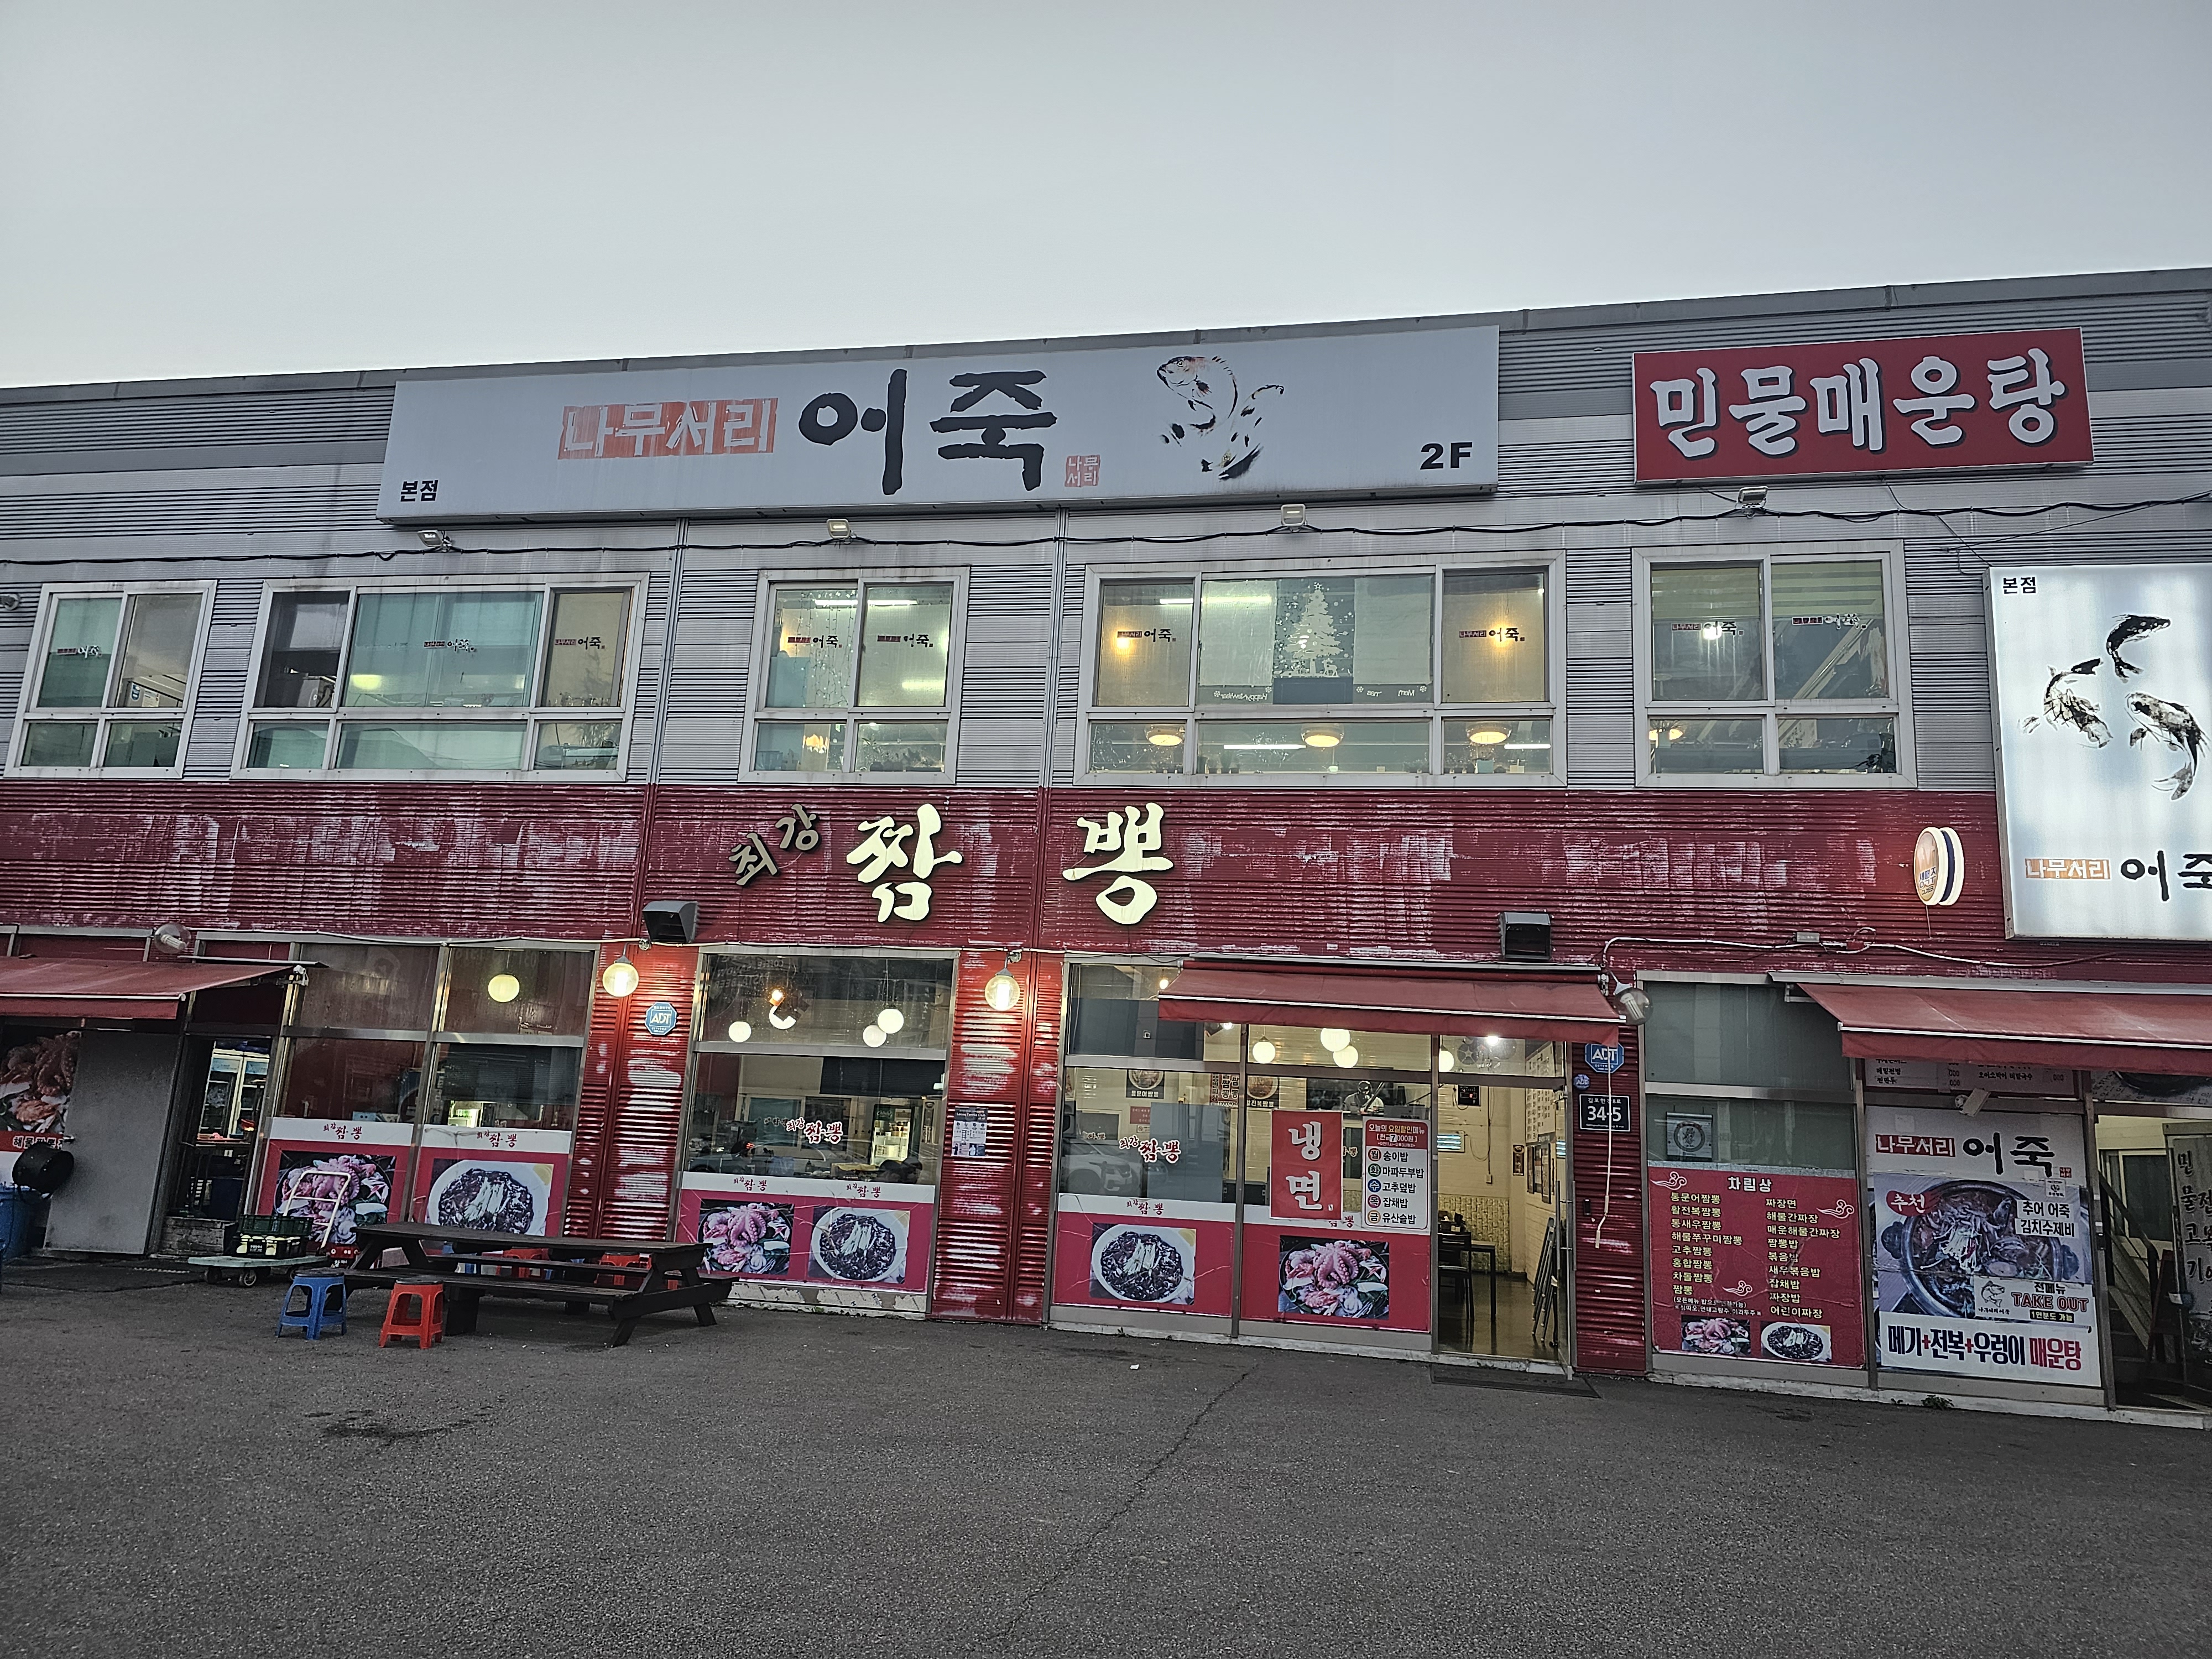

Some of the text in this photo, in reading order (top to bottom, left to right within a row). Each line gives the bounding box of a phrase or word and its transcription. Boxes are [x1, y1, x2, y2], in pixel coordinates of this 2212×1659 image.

[1650, 348, 2067, 461] 민물매운탕
[563, 368, 1057, 495] 나무서리 어죽
[1420, 441, 1473, 470] 2F
[399, 478, 439, 502] 본점
[2002, 576, 2037, 594] 본점
[1144, 628, 1172, 643] 어죽
[1488, 627, 1520, 642] 어죽
[577, 636, 602, 650] 어죽
[727, 802, 1175, 926] 최강 짬뽕
[2025, 858, 2110, 880] 나무서리
[650, 1013, 671, 1024] ADT
[1592, 1047, 1618, 1061] ADT
[1587, 1105, 1622, 1122] 34-5
[1119, 1135, 1139, 1150] 최강
[1138, 1138, 1182, 1164] 짬뽕
[1383, 1150, 1408, 1162] 송이밥
[1876, 1132, 2055, 1178] 나무서리 어죽
[1285, 1121, 1323, 1210] 냉면
[1383, 1166, 1425, 1179] 마파두부밥
[1382, 1181, 1416, 1194] 고추덮밥
[1728, 1176, 1772, 1192] 차림상
[1383, 1197, 1408, 1209] 잡채밥
[1670, 1192, 1721, 1204] 통문어짬뽕
[1766, 1198, 1797, 1209] 짜장면
[1890, 1193, 1926, 1213] 추천
[1671, 1205, 1721, 1218] 활전복짬뽕
[2022, 1201, 2070, 1219] 추어 어죽
[1382, 1212, 1416, 1225] 유산슬밥
[1671, 1218, 1721, 1231] 통새우짬뽕
[1766, 1212, 1818, 1224] 해물간짜장
[1767, 1225, 1840, 1239] 매운해물간짜장
[2020, 1219, 2075, 1238] 김치수제비
[1671, 1231, 1743, 1245] 해물쭈꾸미짬뽕
[1767, 1238, 1798, 1249] 짬뽕밥
[1672, 1245, 1713, 1257] 고추짬뽕
[1768, 1251, 1799, 1263] 볶음밥
[1672, 1258, 1713, 1270] 홍합짬뽕
[1672, 1271, 1713, 1284] 차돌짬뽕
[1768, 1265, 1820, 1278] 새우볶음밥
[1673, 1284, 1693, 1295] 짬뽕
[1769, 1278, 1800, 1290] 잡채밥
[2034, 1281, 2066, 1295] 전메뉴
[1769, 1292, 1801, 1303] 짜장밥
[2011, 1291, 2090, 1312] TAKE OUT
[1770, 1306, 1823, 1319] 어린이짜장
[2029, 1337, 2082, 1371] 매운탕
